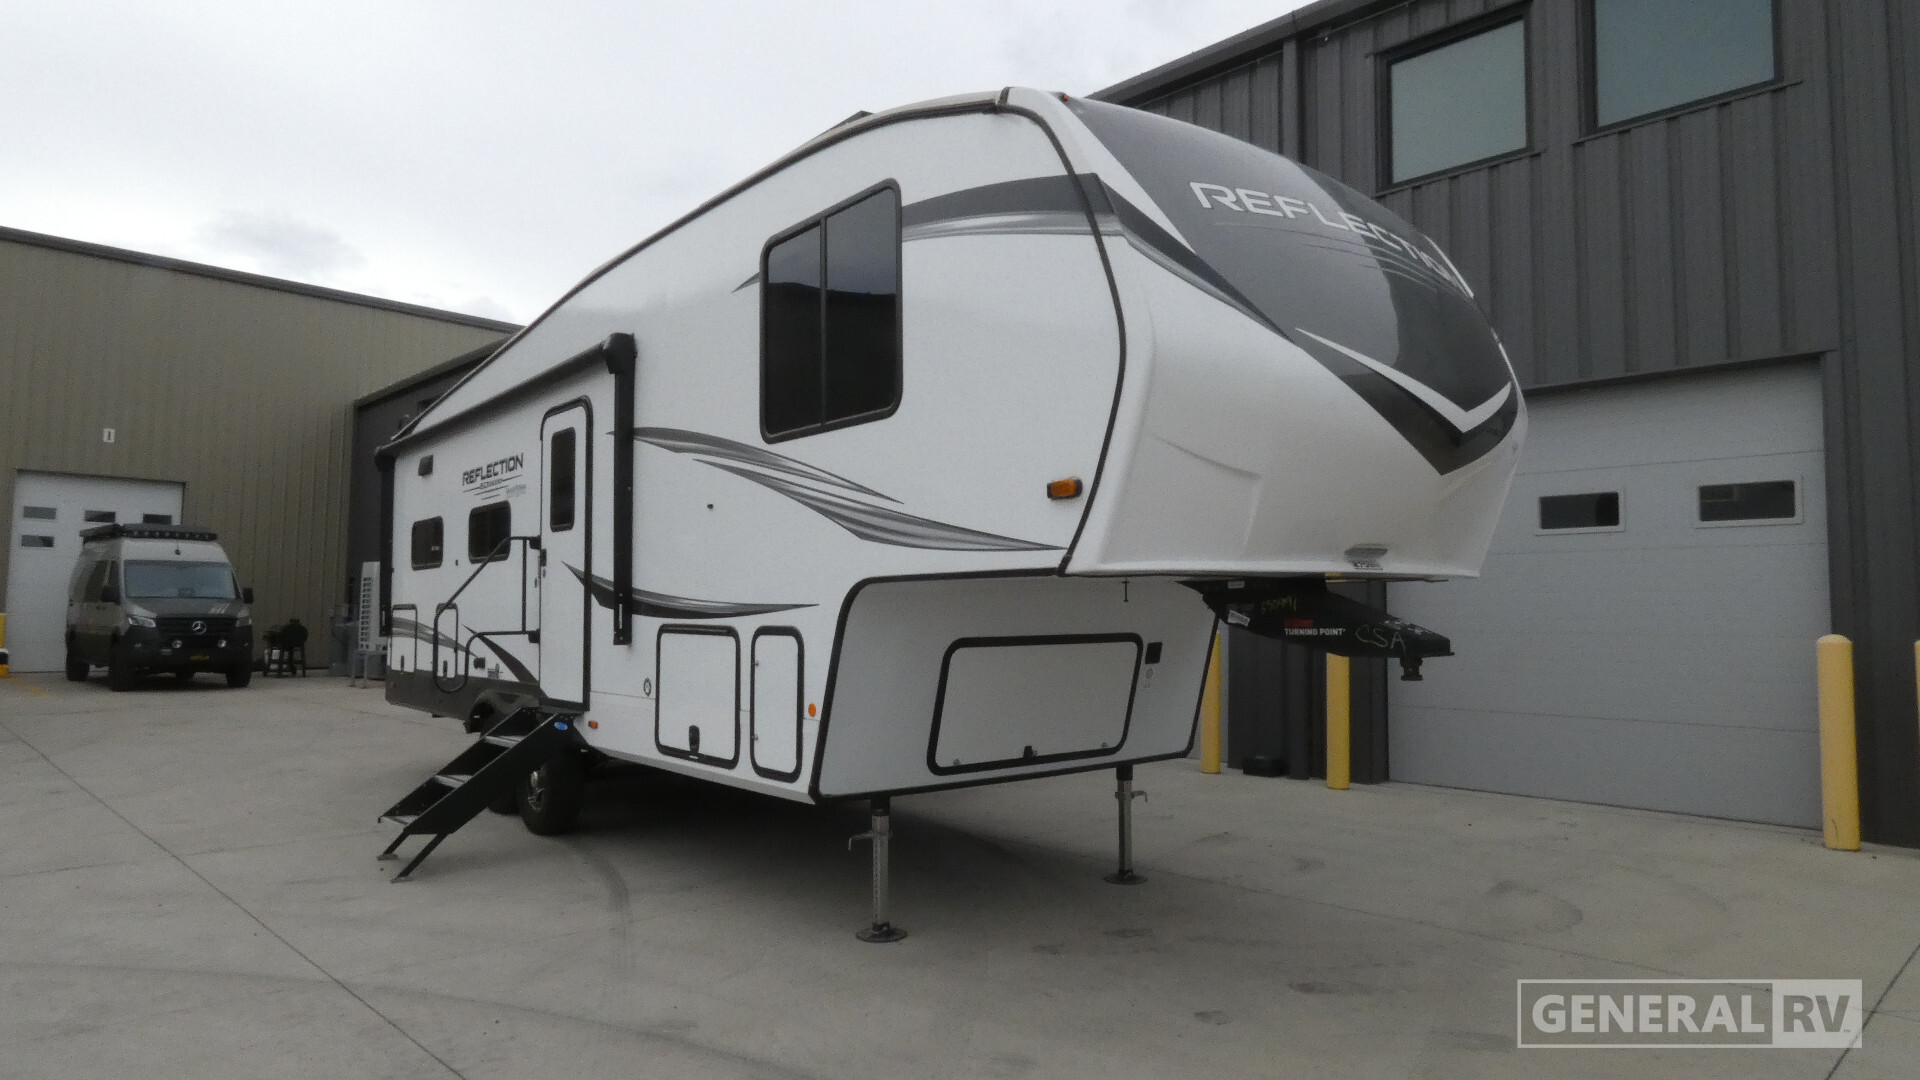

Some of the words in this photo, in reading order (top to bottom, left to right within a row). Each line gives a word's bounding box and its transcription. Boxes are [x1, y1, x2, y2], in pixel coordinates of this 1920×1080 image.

[462, 452, 524, 486] REFLECTION
[1284, 628, 1318, 636] TURNING
[1355, 625, 1405, 652] CSA
